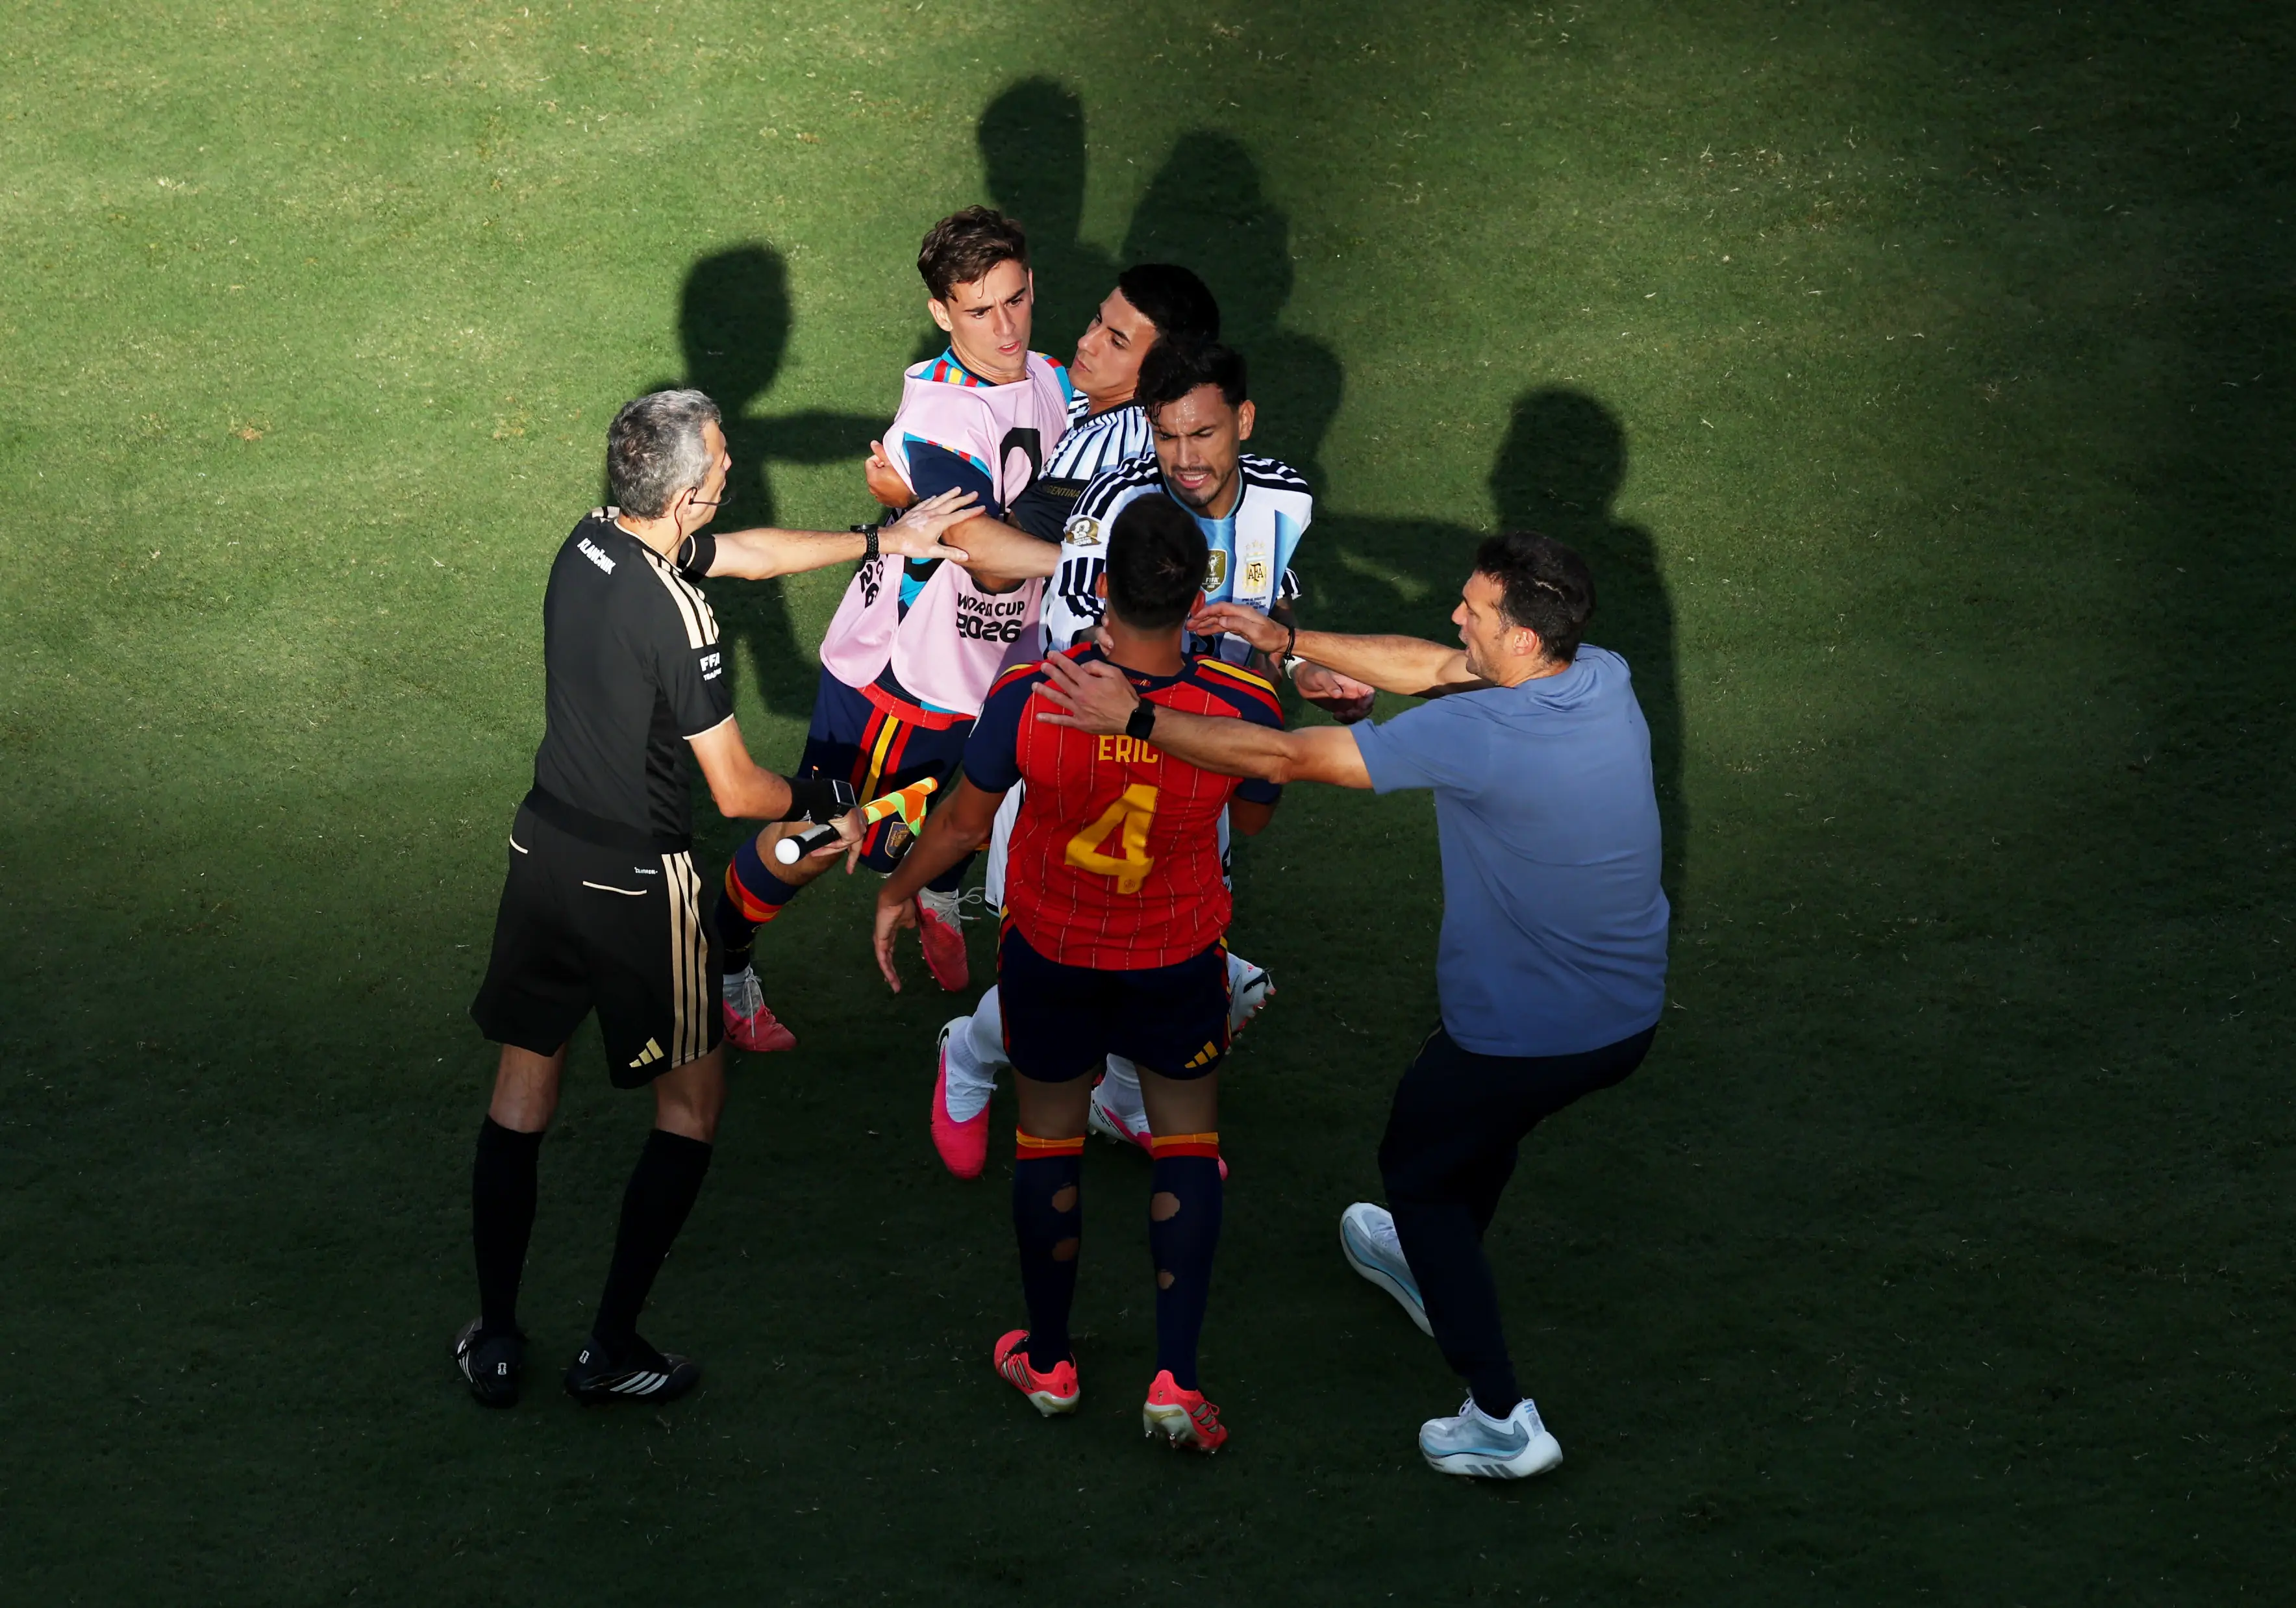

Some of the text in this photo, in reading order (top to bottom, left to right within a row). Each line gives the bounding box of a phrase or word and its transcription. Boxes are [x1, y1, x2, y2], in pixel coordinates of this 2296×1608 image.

[1248, 563, 1264, 581] AFA
[995, 601, 1025, 616] CUP
[956, 611, 1022, 643] 2026
[1064, 783, 1159, 894] 4
